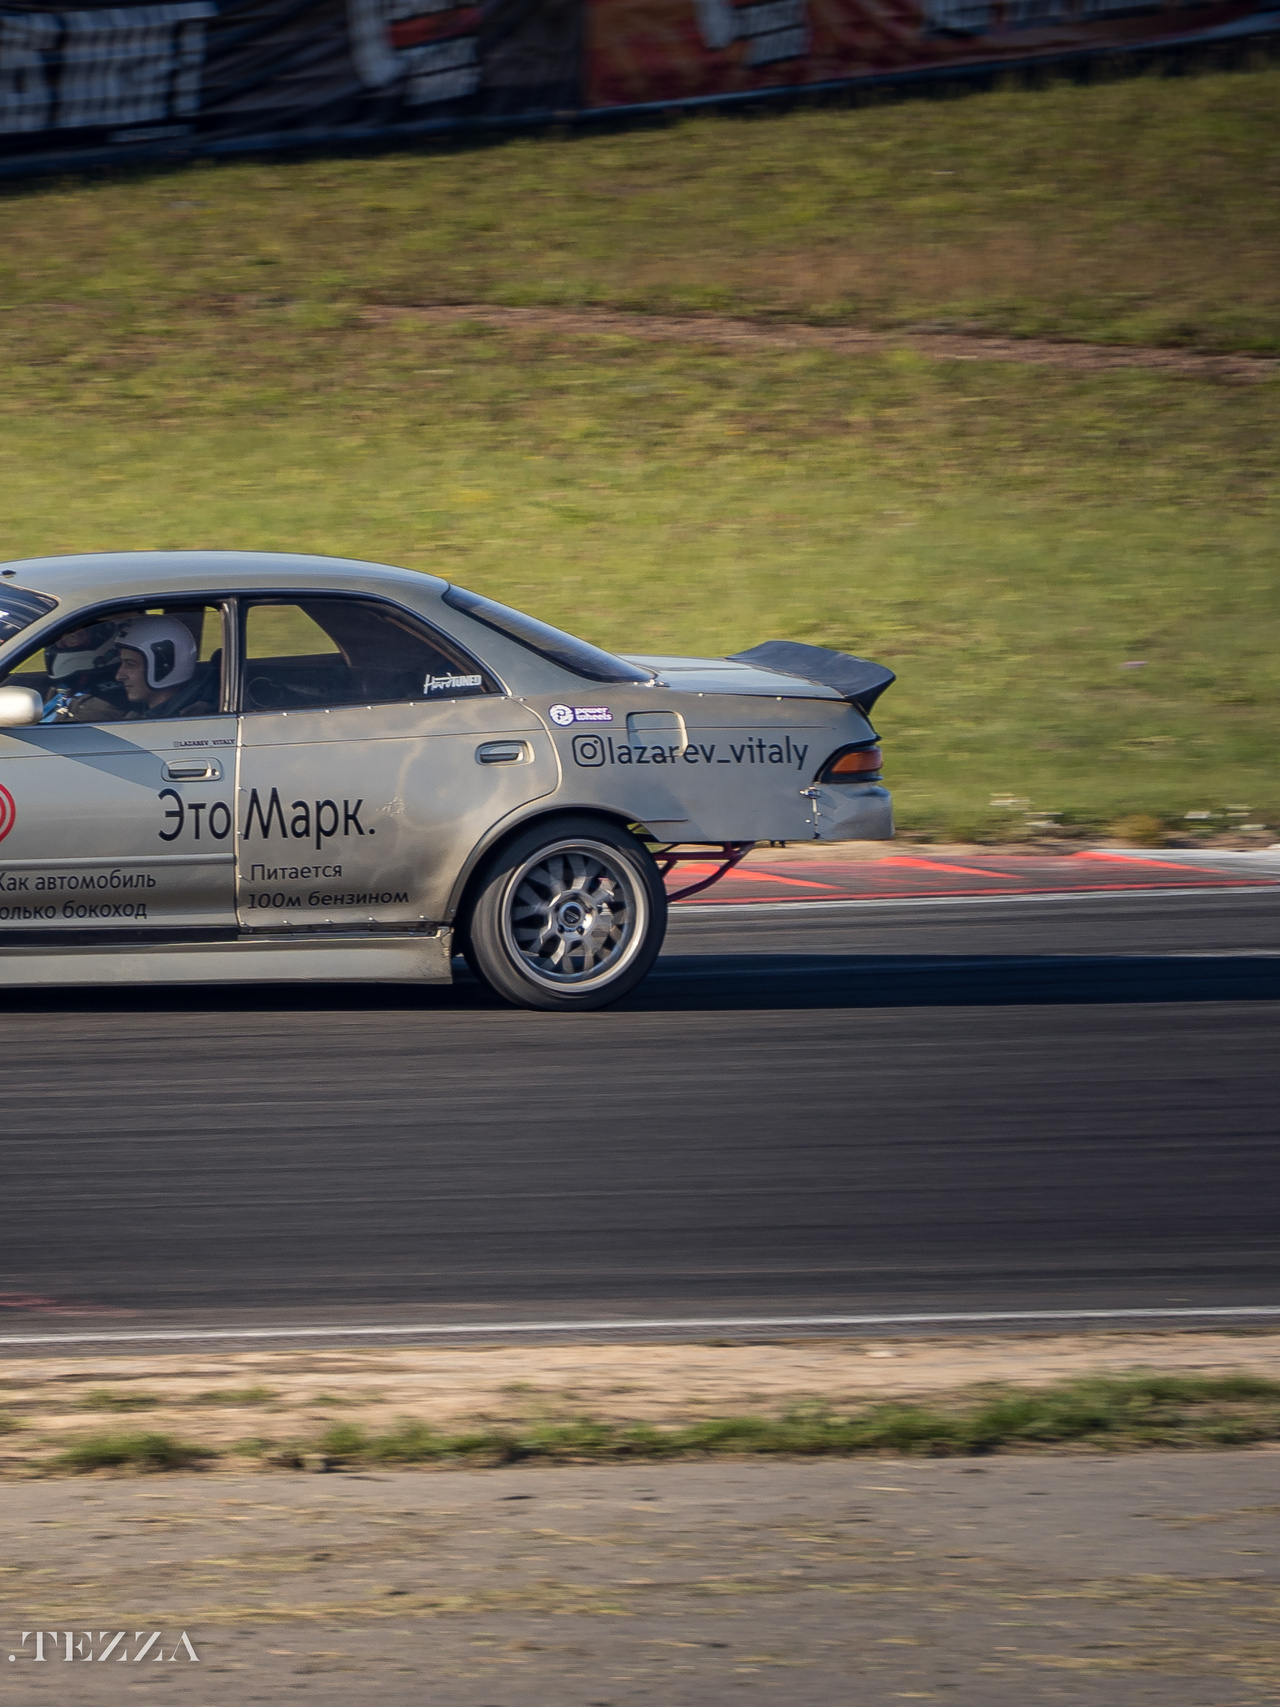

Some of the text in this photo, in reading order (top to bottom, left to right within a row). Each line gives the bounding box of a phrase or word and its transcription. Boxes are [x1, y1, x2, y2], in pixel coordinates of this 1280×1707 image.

[607, 735, 809, 771] lazarev_vitaly
[157, 786, 376, 851] Это Марк.
[35, 869, 157, 891] автомобиль
[250, 863, 342, 882] Питается
[62, 900, 148, 919] бокоход
[247, 891, 410, 909] 100м бензином
